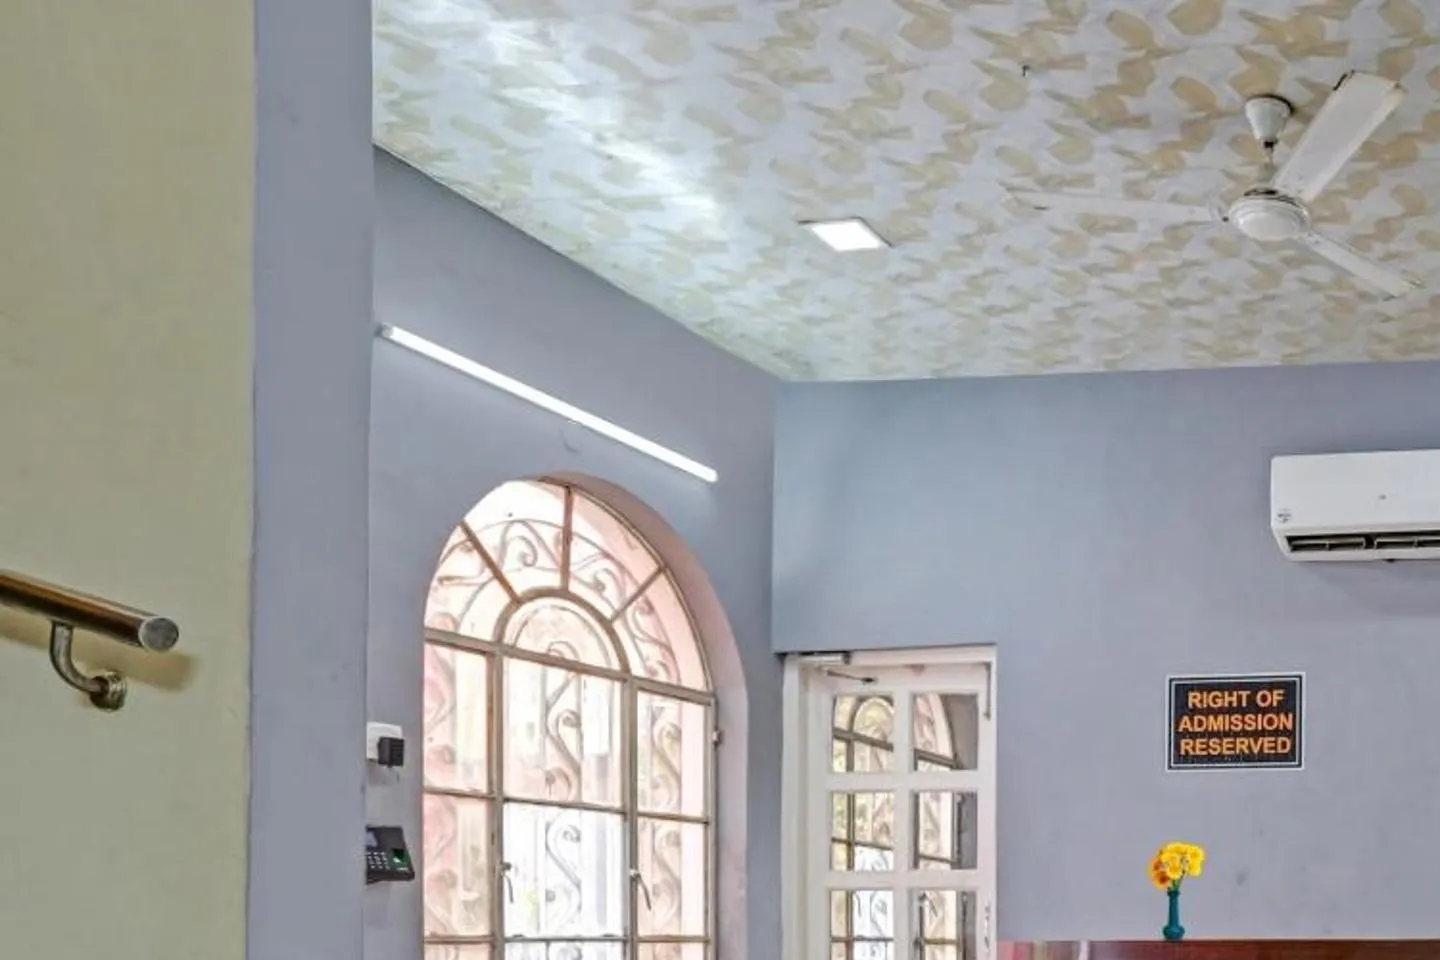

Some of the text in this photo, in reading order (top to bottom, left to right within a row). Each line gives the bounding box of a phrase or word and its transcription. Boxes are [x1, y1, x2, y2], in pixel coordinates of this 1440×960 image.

[1187, 689, 1286, 709] RIGHT OF
[1178, 712, 1294, 732] ADMISSION
[1180, 737, 1292, 756] RESERVED
